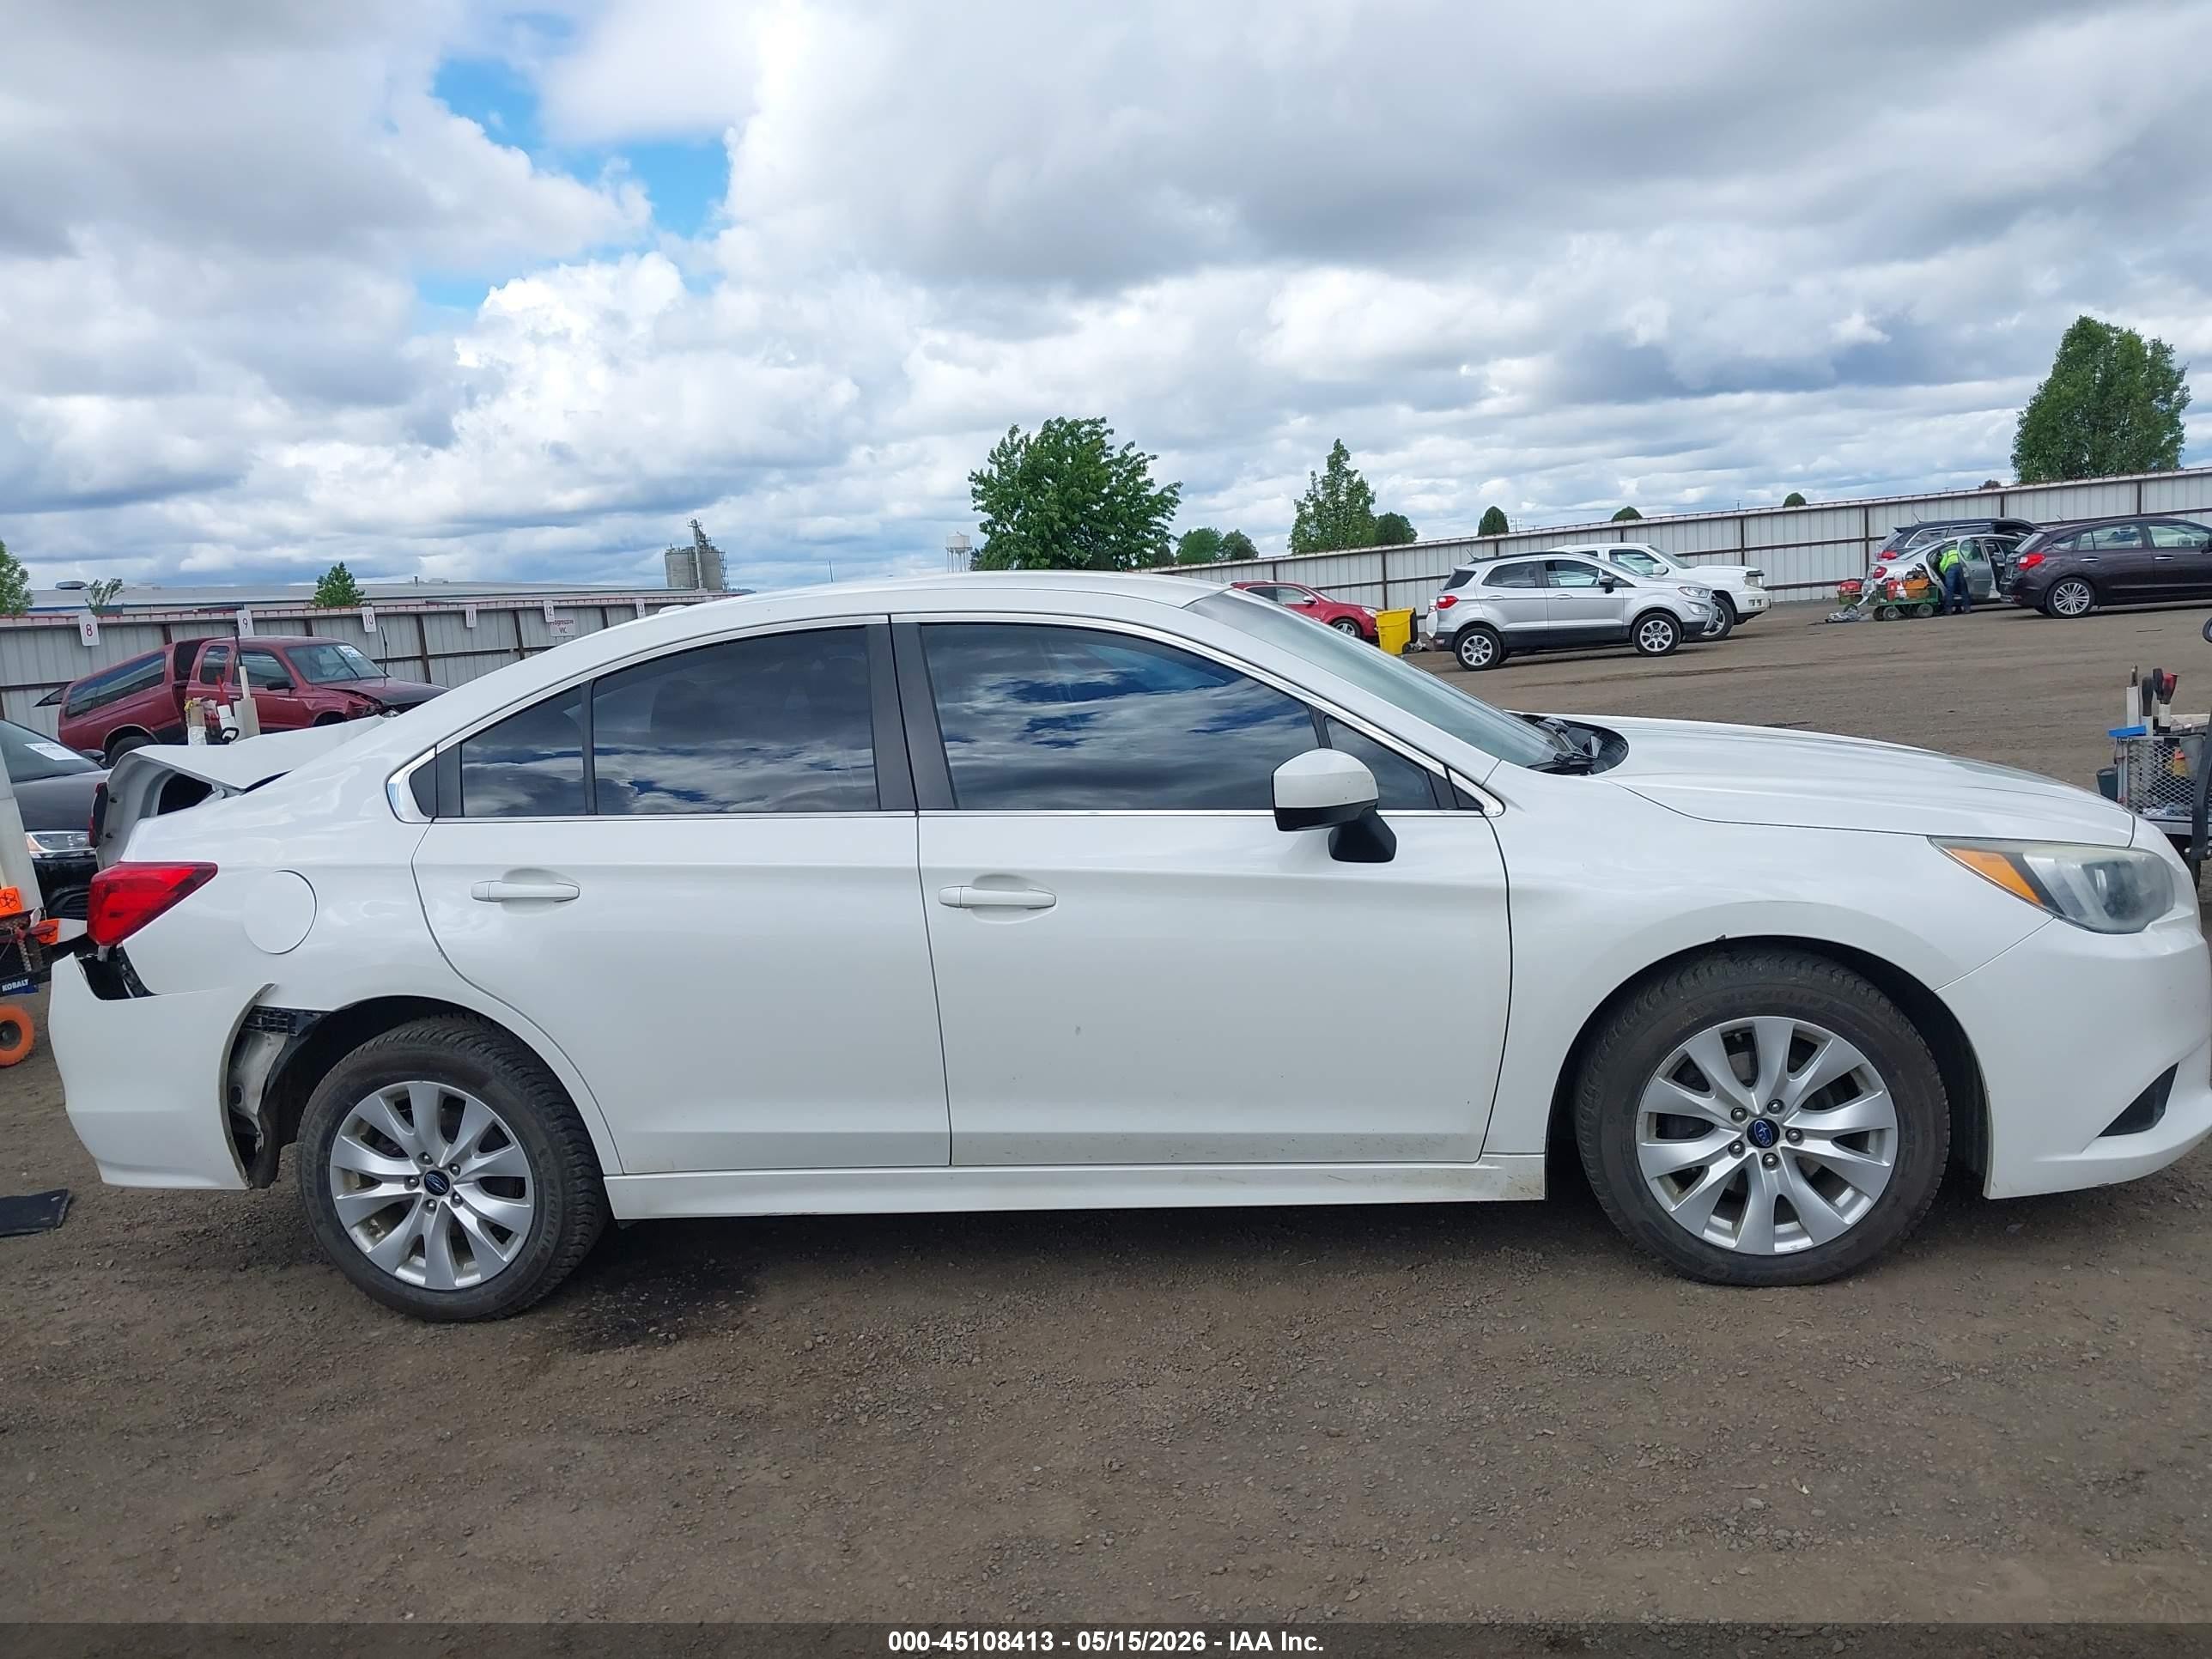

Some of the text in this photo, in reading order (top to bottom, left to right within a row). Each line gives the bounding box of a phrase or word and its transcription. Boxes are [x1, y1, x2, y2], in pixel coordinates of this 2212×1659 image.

[468, 611, 474, 621] 11
[546, 605, 554, 617] 12
[242, 617, 248, 629] 9
[364, 614, 374, 625] 10
[86, 623, 93, 636] 8
[2, 978, 28, 992] KOBALT
